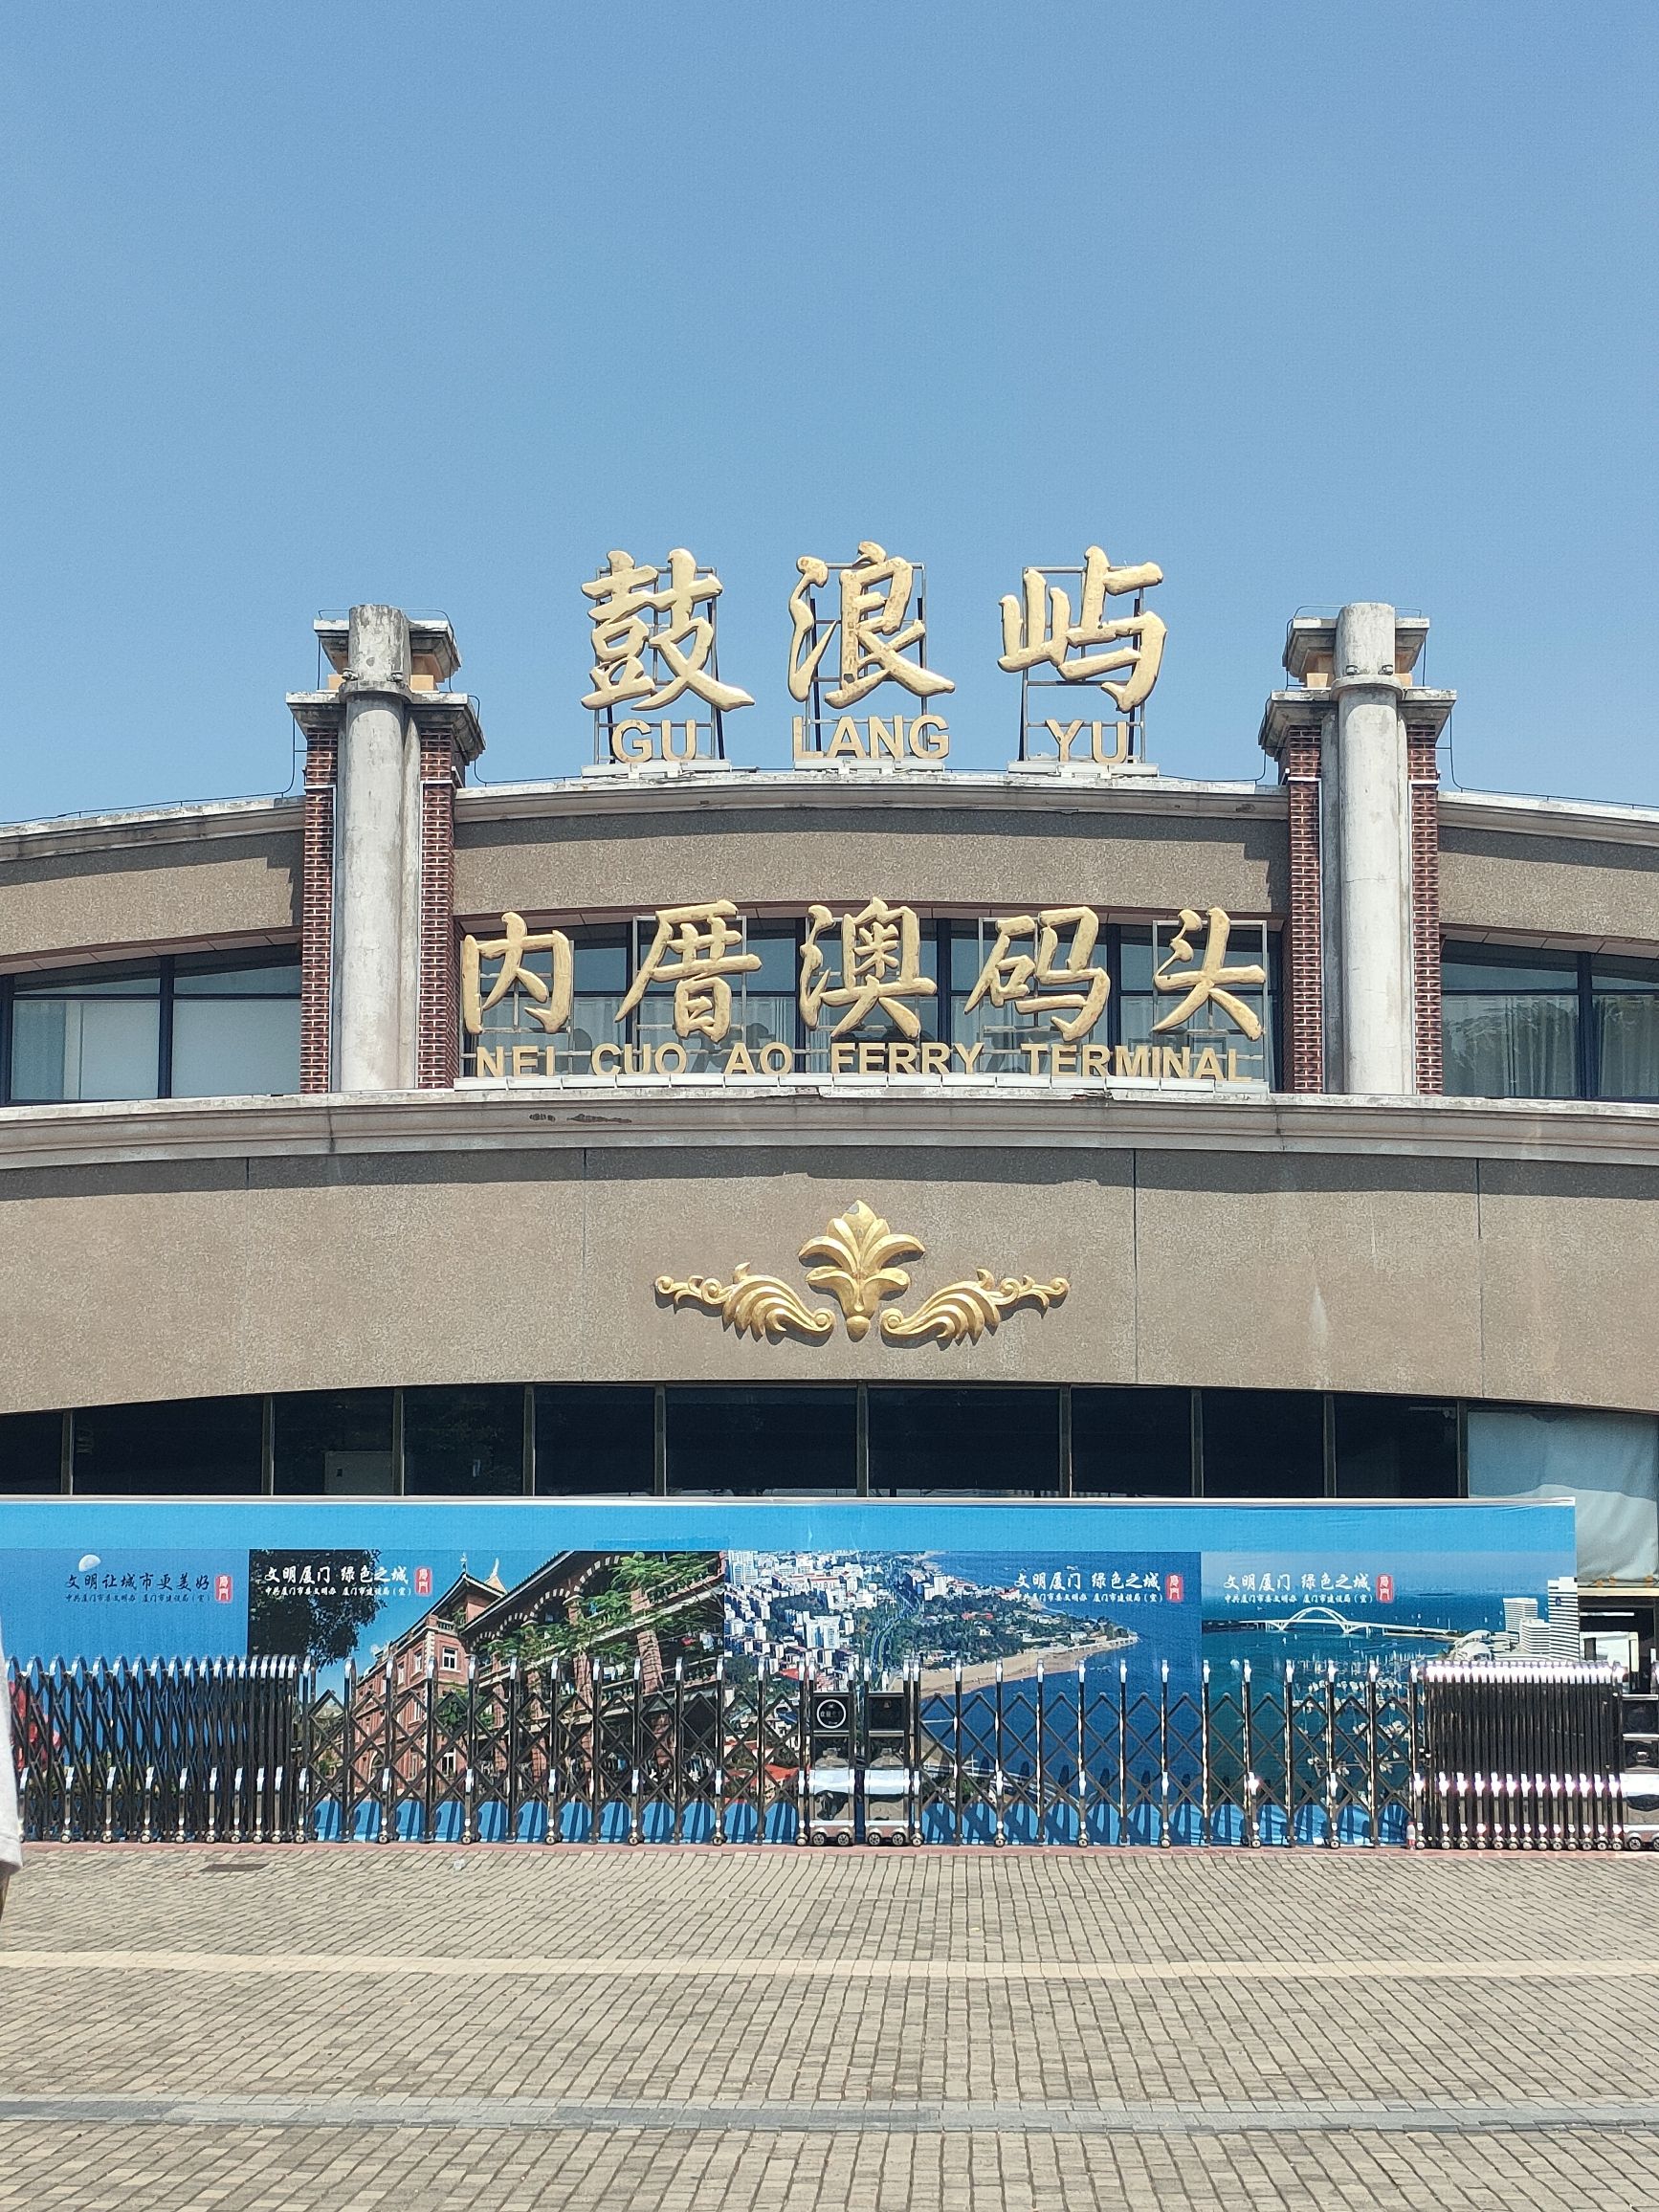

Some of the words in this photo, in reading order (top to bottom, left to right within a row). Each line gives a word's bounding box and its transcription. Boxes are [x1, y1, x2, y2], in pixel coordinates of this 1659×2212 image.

[582, 541, 1167, 713] 鼓浪屿
[611, 719, 697, 763] GU
[792, 715, 950, 760] LANG
[1045, 719, 1129, 763] YU
[462, 898, 1266, 1042] 内厝澳码头
[476, 1045, 556, 1077] NEI
[591, 1043, 687, 1075] CUO
[723, 1042, 794, 1074] AO
[830, 1042, 984, 1074] FERRY
[1020, 1043, 1252, 1081] TERMINAL
[66, 1572, 210, 1591] 文明让城市更美好
[264, 1565, 331, 1584] 文明厦门
[341, 1564, 409, 1584] 绿色之城
[1014, 1571, 1082, 1591] 文明厦门
[1091, 1571, 1161, 1591] 绿色之城
[1223, 1572, 1292, 1591] 文明厦门
[1301, 1572, 1371, 1592] 绿色之城
